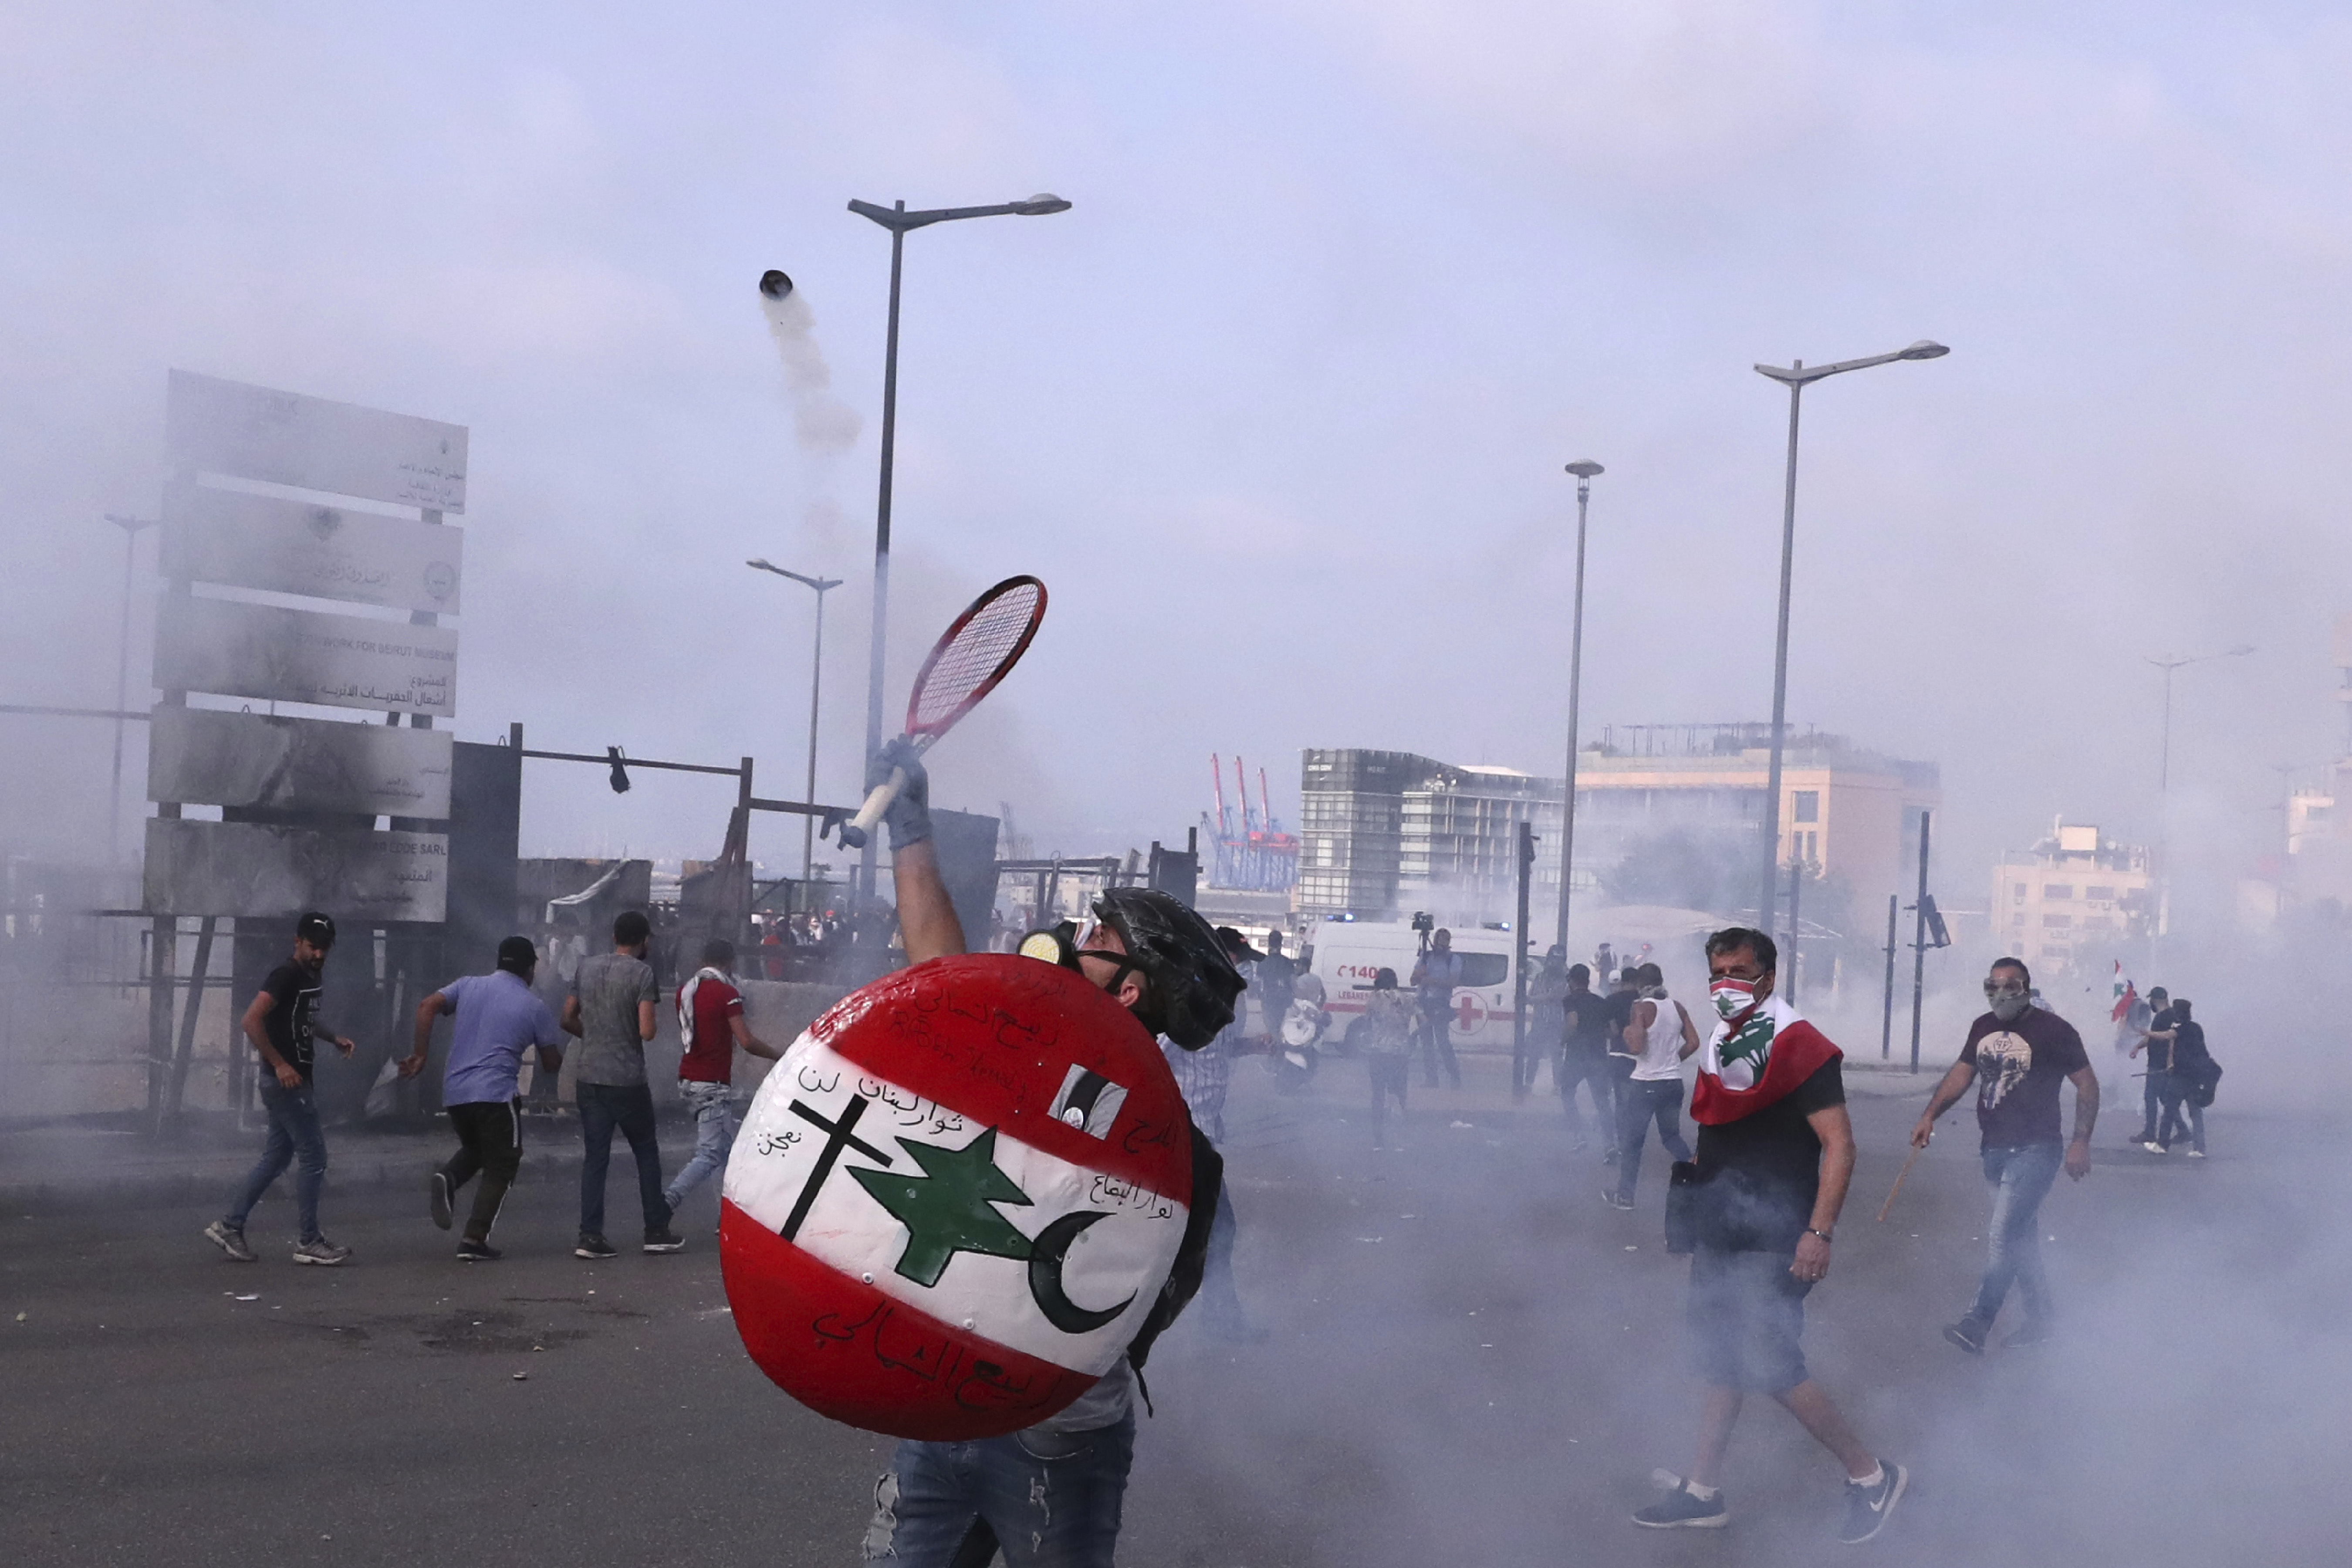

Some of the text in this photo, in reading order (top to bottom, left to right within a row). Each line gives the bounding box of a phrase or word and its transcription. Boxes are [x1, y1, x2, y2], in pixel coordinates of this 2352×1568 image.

[356, 640, 377, 653] FOR
[378, 642, 413, 657] BEIRUT
[414, 645, 456, 662] MUSEUM
[420, 843, 446, 856] SARL
[1349, 966, 1379, 979] 140
[798, 1065, 962, 1134] ثوار لبنان لن
